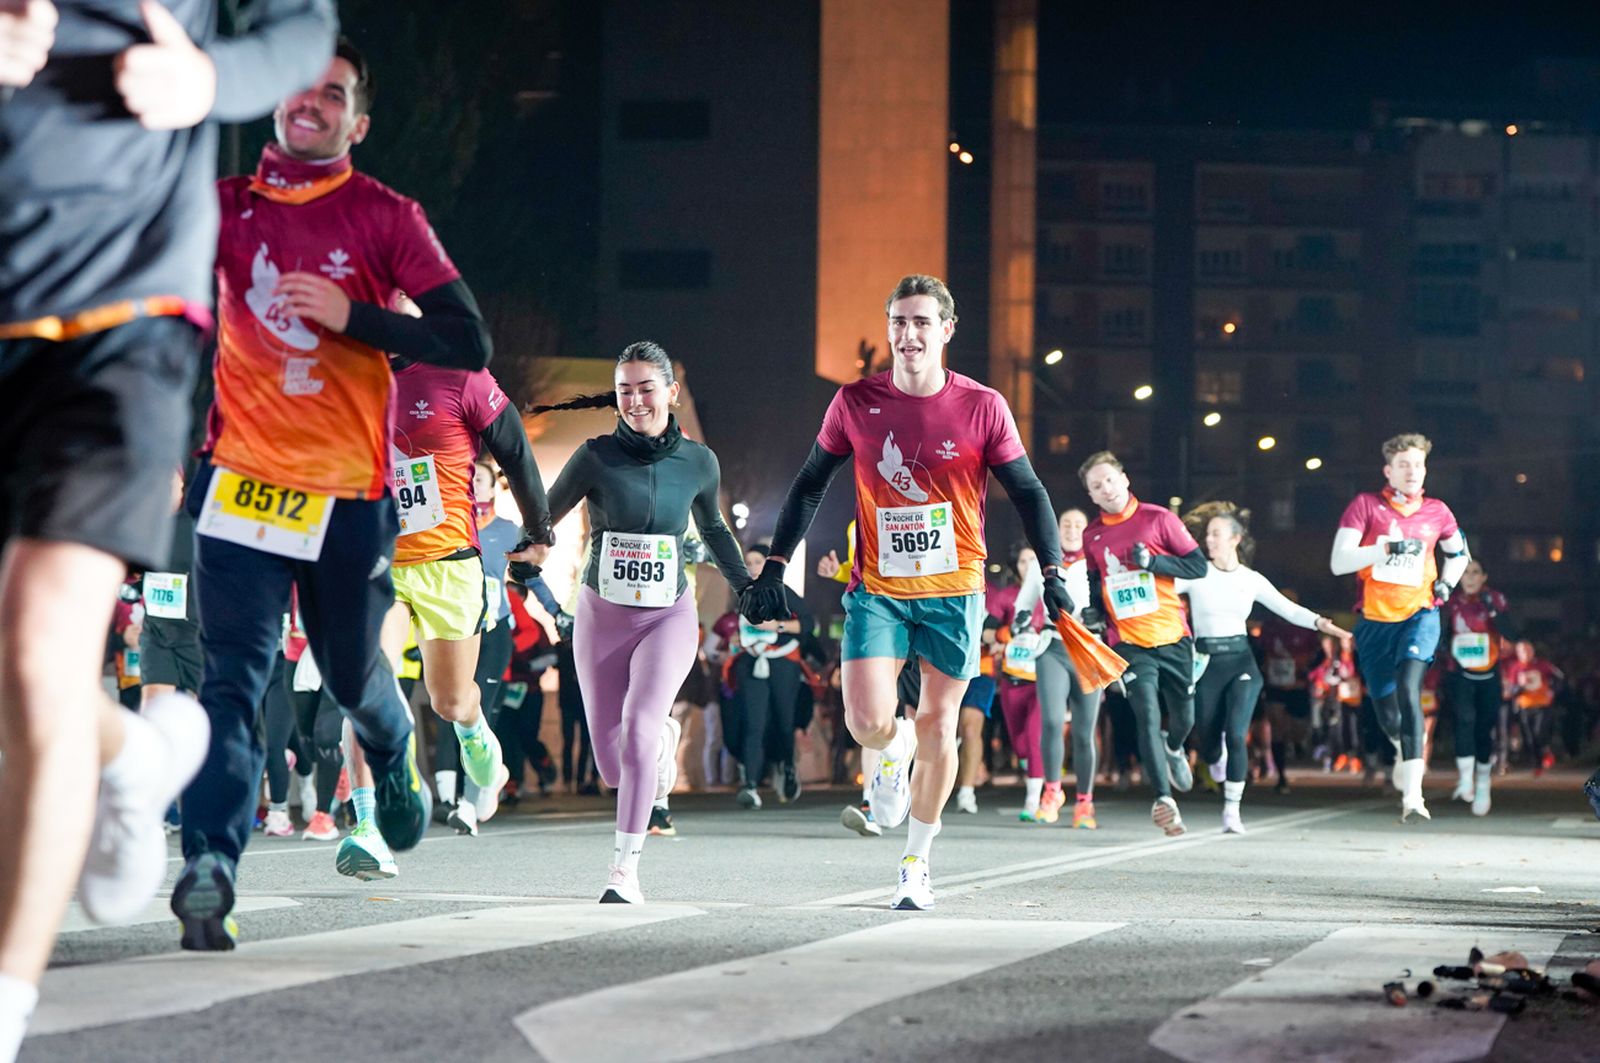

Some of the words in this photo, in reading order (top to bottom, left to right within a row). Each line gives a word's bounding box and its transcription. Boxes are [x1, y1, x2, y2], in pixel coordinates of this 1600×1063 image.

[395, 470, 405, 478] DE
[891, 471, 911, 491] 43
[234, 479, 308, 521] 8512
[396, 485, 427, 509] 94
[915, 513, 924, 521] DE
[885, 523, 899, 531] SAN
[619, 542, 642, 550] NOCHE
[891, 529, 942, 554] 5692
[609, 549, 625, 558] SAN
[613, 559, 665, 582] 5693
[152, 588, 174, 603] 7176
[1117, 586, 1146, 604] 8310
